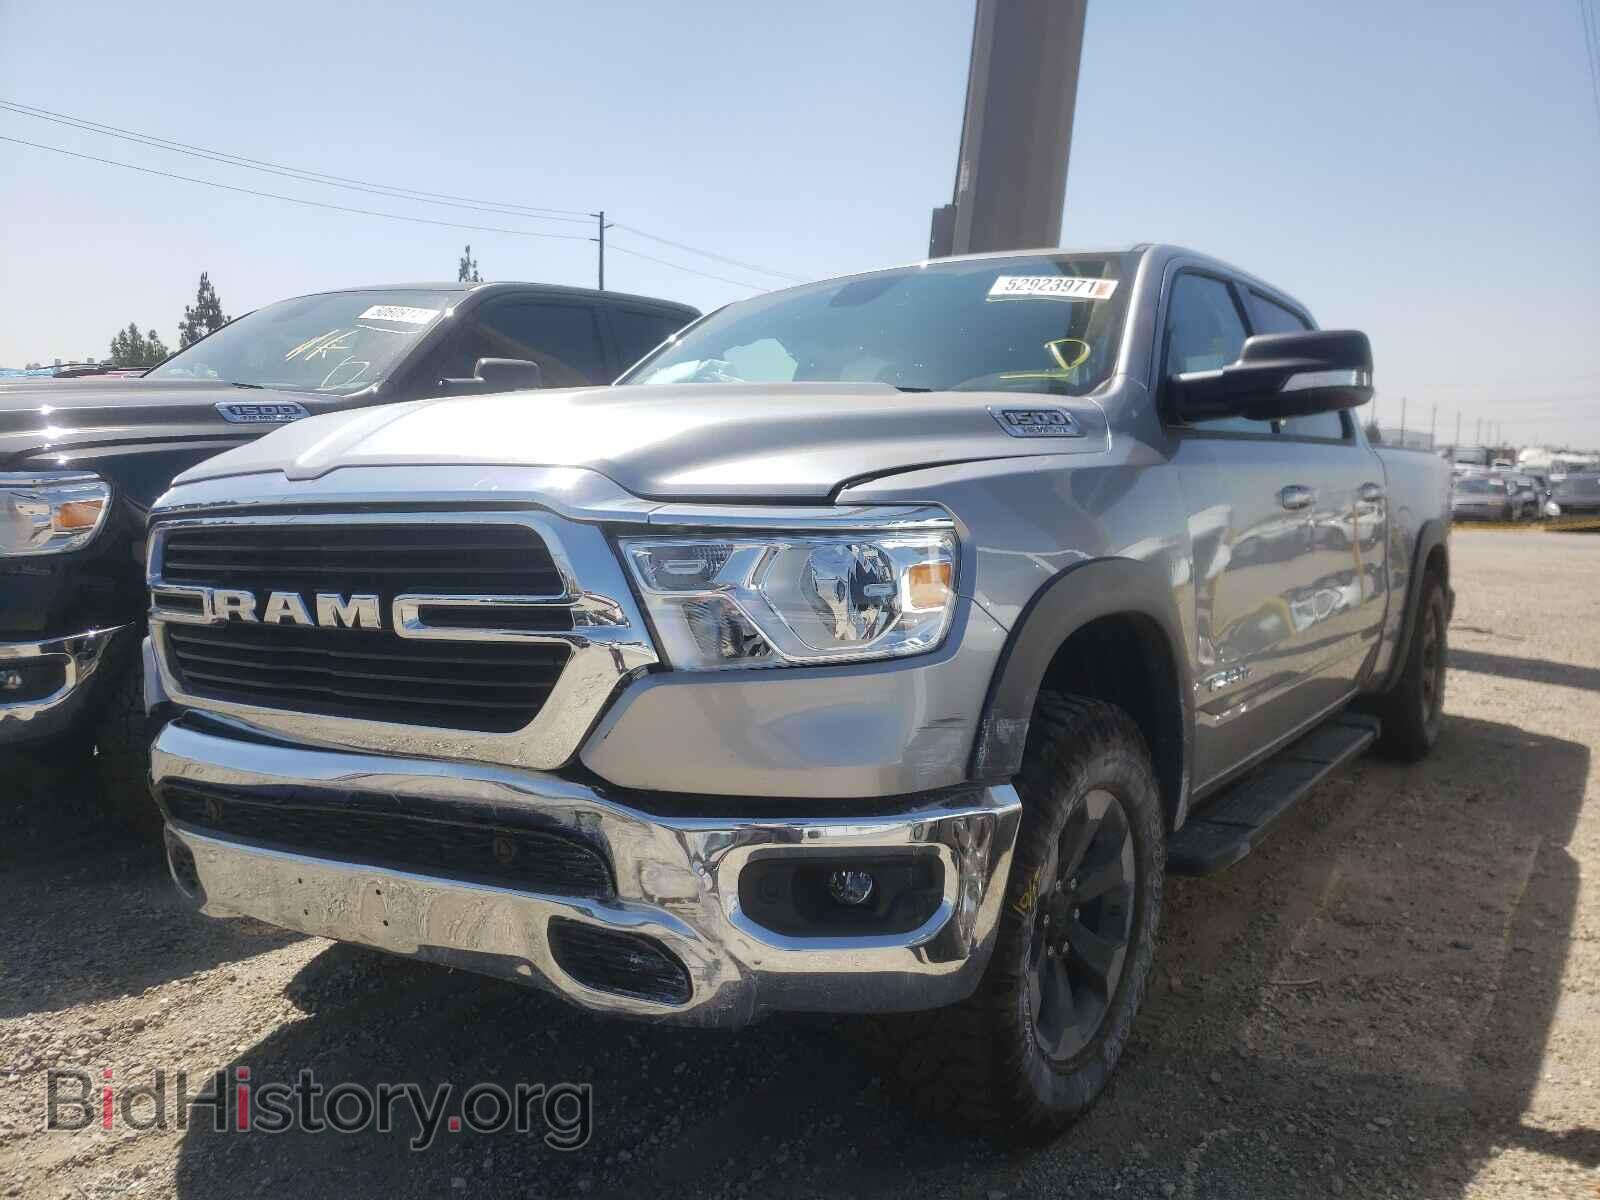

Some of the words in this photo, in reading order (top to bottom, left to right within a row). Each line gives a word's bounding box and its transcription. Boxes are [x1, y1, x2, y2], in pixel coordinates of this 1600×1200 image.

[1004, 278, 1097, 294] 52923971
[230, 404, 299, 416] 1500
[1005, 411, 1068, 425] 1500
[208, 589, 382, 630] RAM
